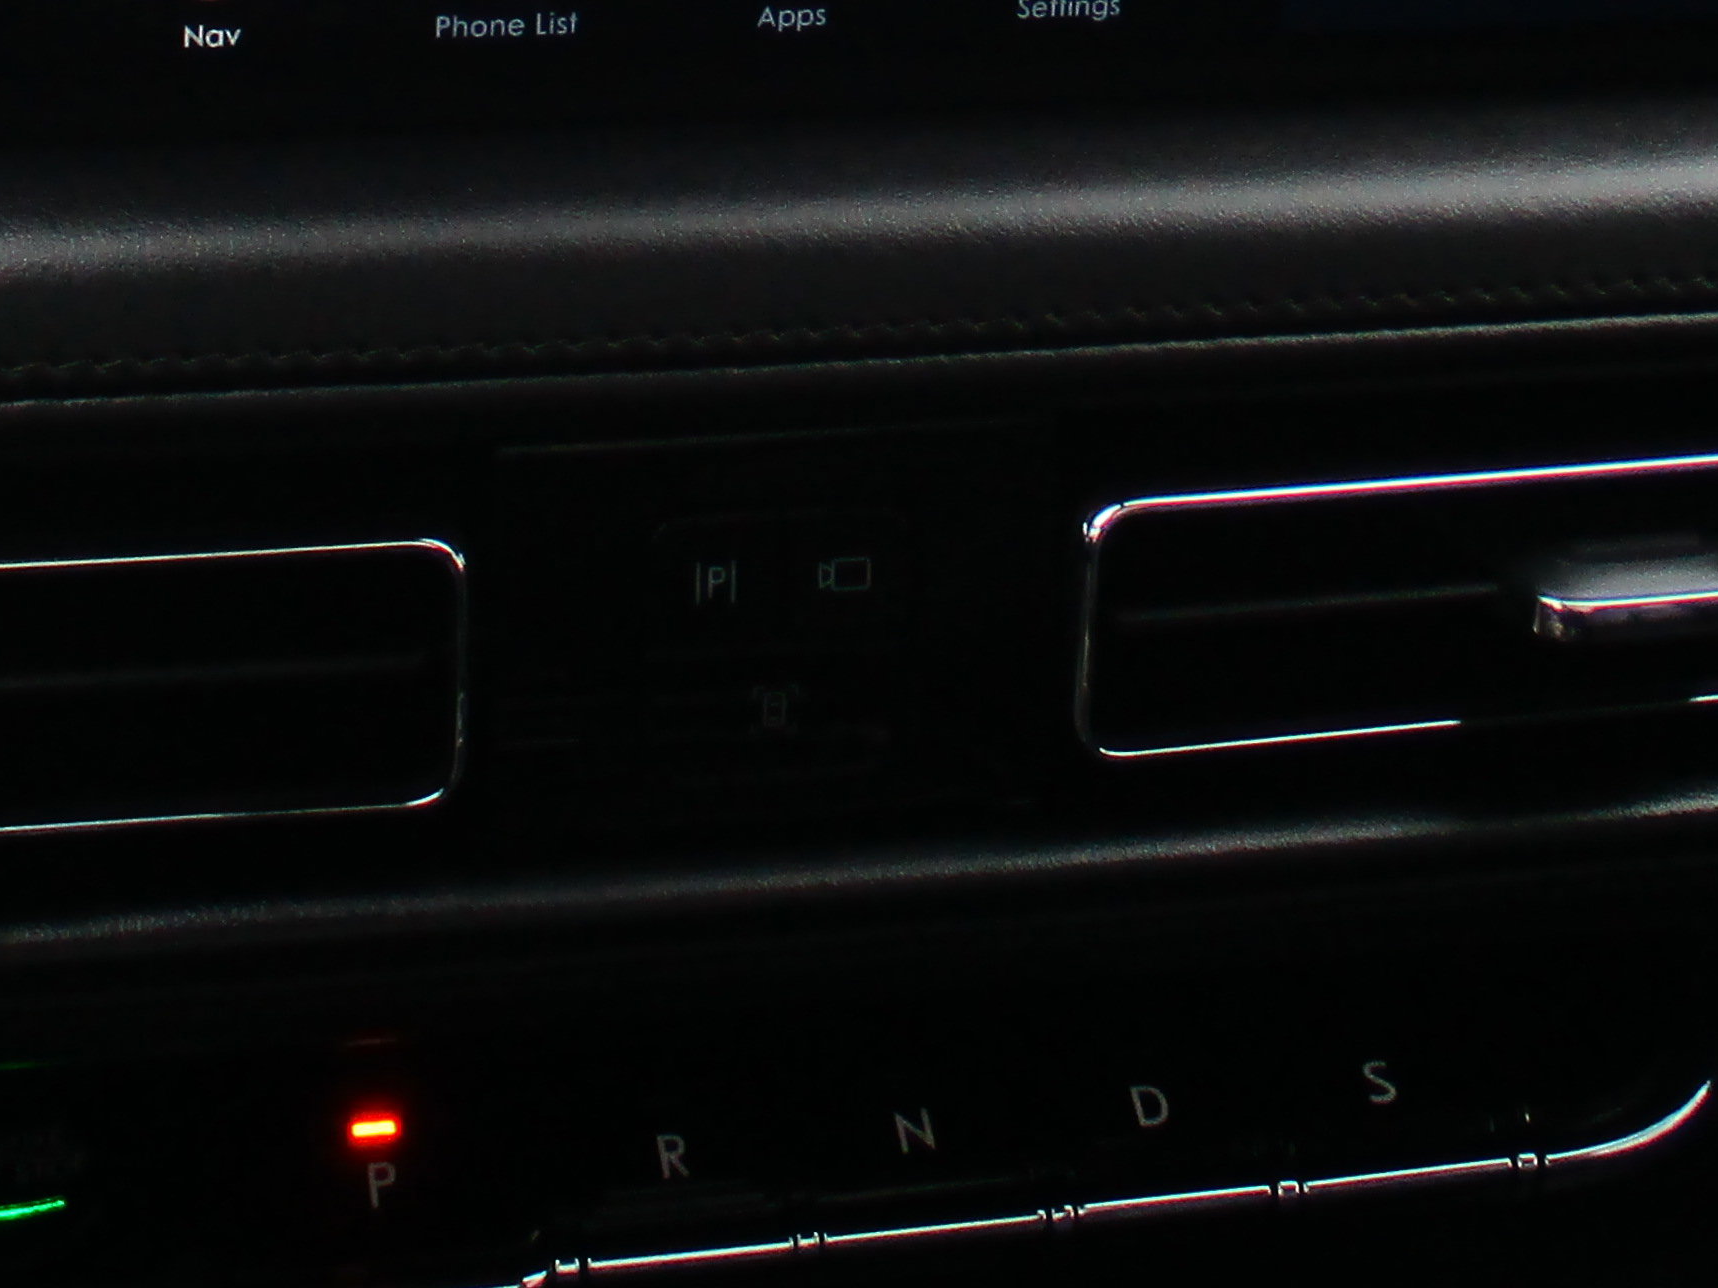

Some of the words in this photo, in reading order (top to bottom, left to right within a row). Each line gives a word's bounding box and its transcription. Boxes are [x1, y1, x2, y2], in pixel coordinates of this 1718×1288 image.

[435, 15, 526, 38] Phone
[535, 12, 578, 36] List
[757, 6, 827, 32] Apps
[183, 24, 241, 48] Nav
[367, 1160, 396, 1208] P
[656, 1134, 689, 1179] R
[894, 1108, 936, 1154] N
[1130, 1086, 1169, 1127] D
[1362, 1060, 1397, 1104] S
